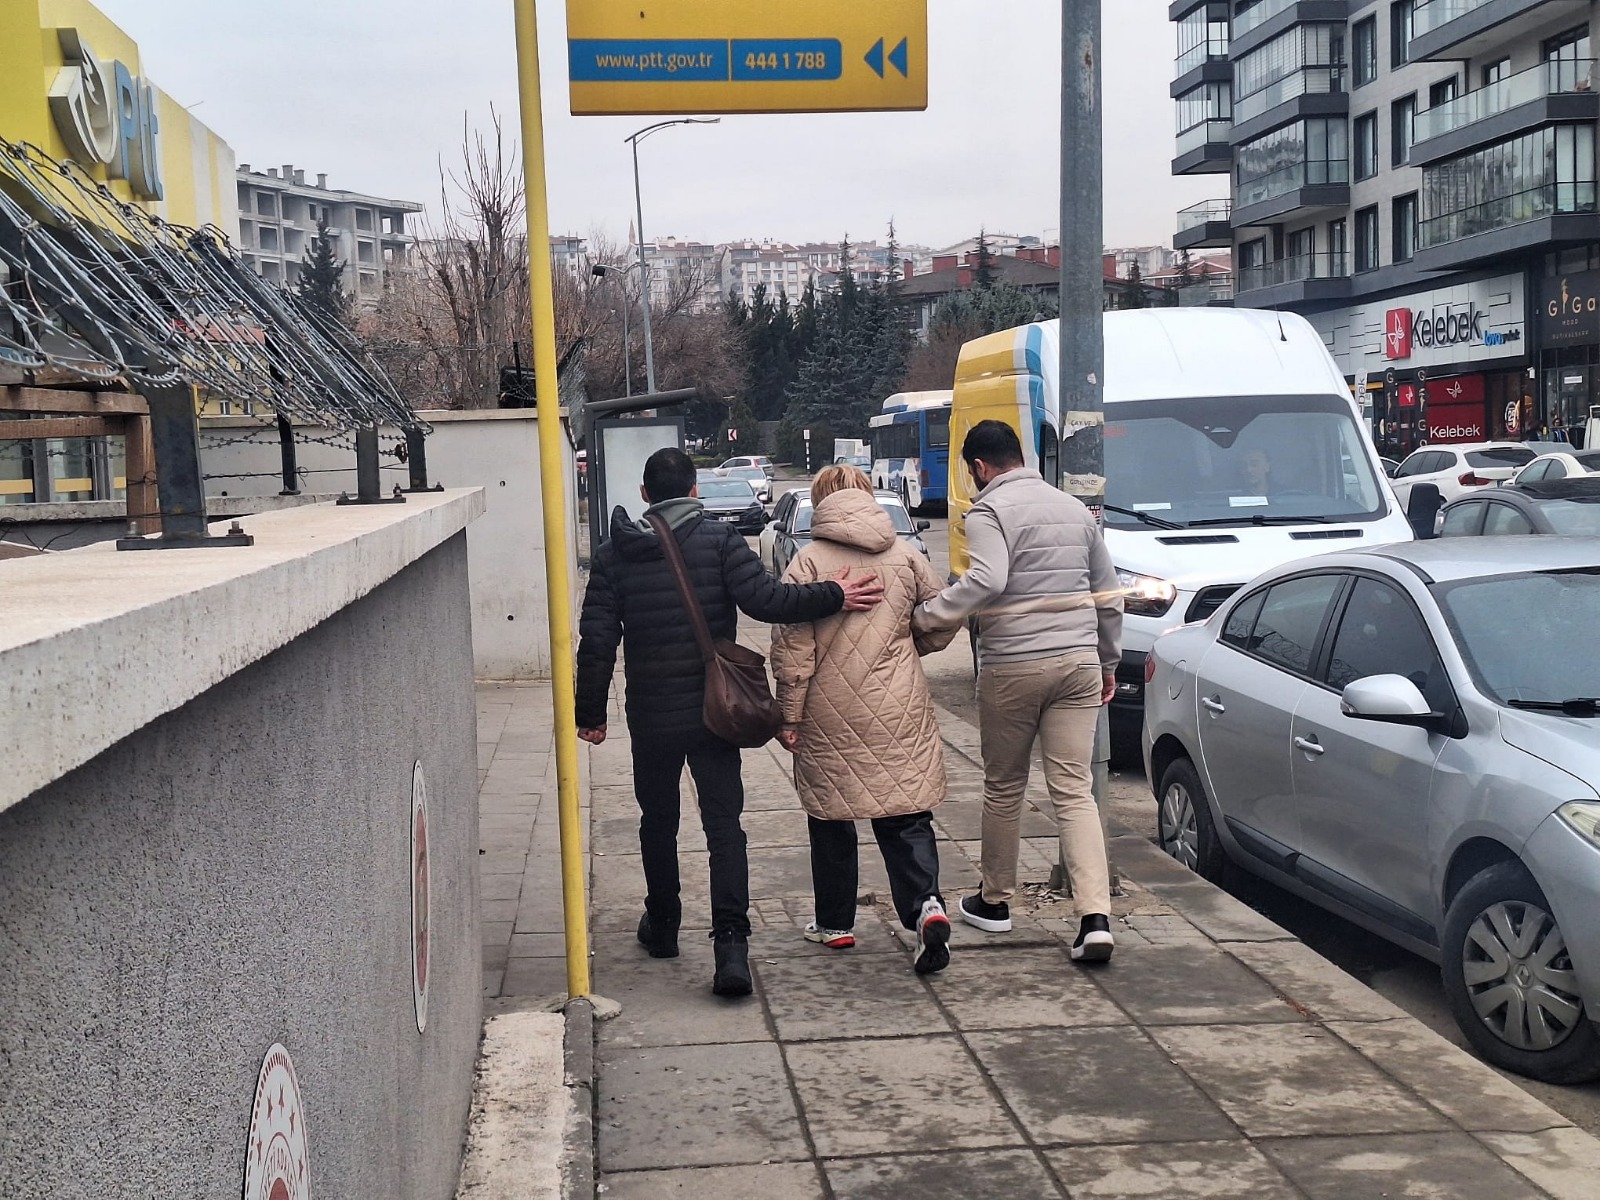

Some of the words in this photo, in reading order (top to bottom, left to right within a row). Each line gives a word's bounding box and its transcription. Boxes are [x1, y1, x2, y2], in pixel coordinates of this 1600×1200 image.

[595, 51, 713, 72] www.ptt.gov.tr
[745, 52, 778, 70] 444
[783, 52, 790, 70] 1
[795, 52, 825, 70] 788
[1410, 301, 1483, 348] Kelebek
[1430, 423, 1481, 439] Kelebek
